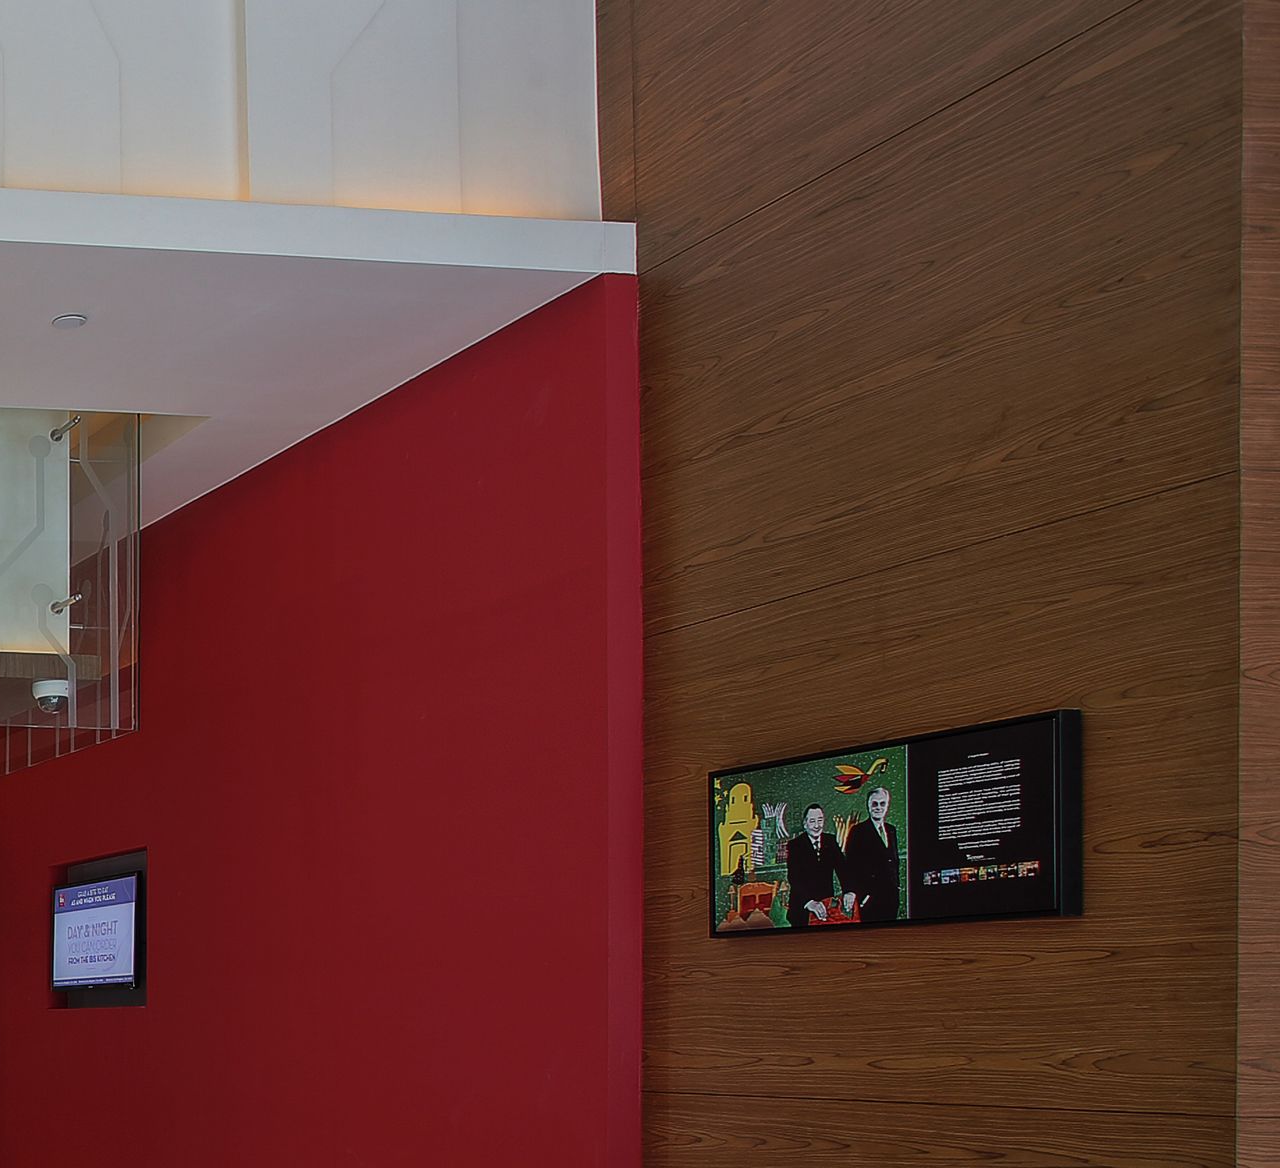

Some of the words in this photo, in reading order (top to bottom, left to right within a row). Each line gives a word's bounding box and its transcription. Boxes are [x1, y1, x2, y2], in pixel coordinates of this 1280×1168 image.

[67, 925, 82, 940] DAY
[83, 924, 90, 938] &
[91, 920, 119, 937] NIGHT
